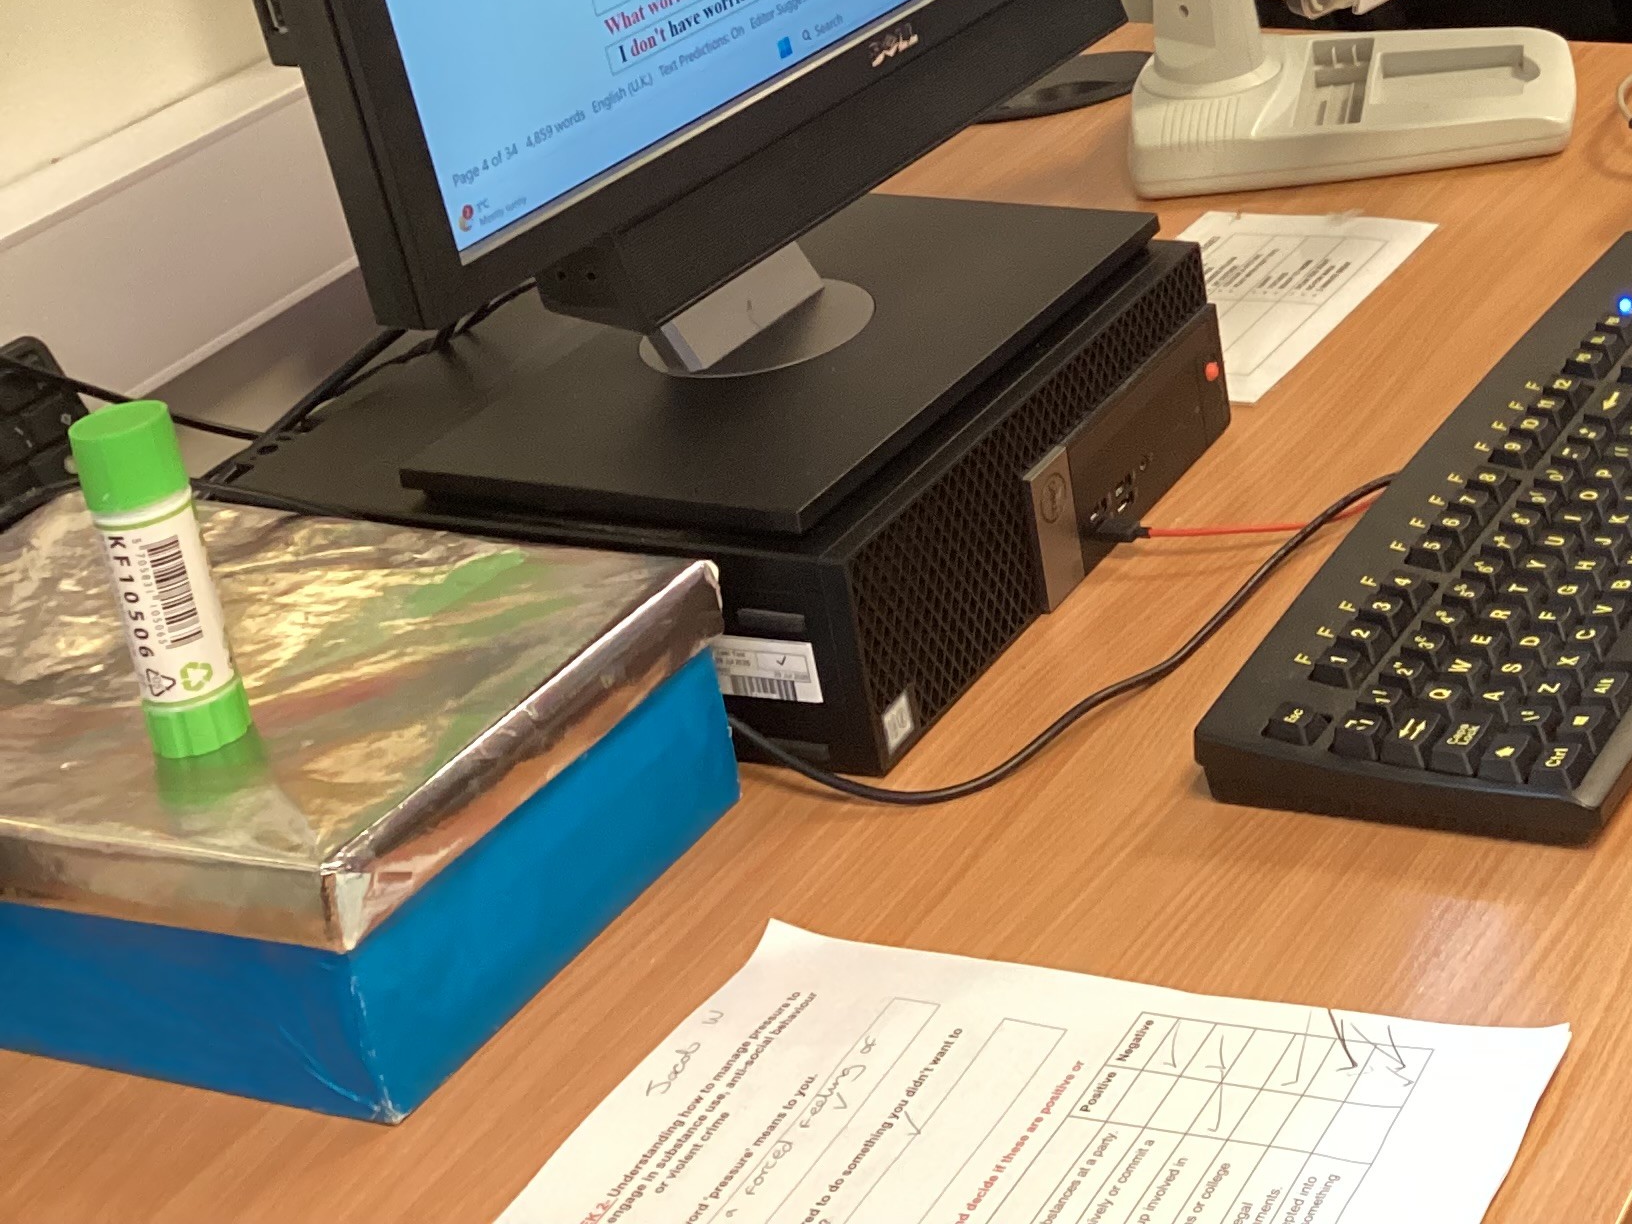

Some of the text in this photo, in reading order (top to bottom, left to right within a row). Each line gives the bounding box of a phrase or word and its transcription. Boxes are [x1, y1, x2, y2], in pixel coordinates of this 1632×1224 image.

[618, 44, 629, 65] I
[629, 27, 668, 59] don't
[668, 11, 701, 39] have
[107, 536, 155, 657] KF10506
[1593, 676, 1616, 695] Alt
[1545, 746, 1570, 769] Ctrl
[1116, 1019, 1155, 1063] Negative
[606, 990, 801, 1199] Understanding how to manage pressure to
[607, 991, 819, 1224] engage in substance use, anti-social behaviour
[1079, 1070, 1119, 1114] Positive
[653, 1110, 731, 1195] or violent crime
[966, 1059, 1085, 1209] decide if these are positive or
